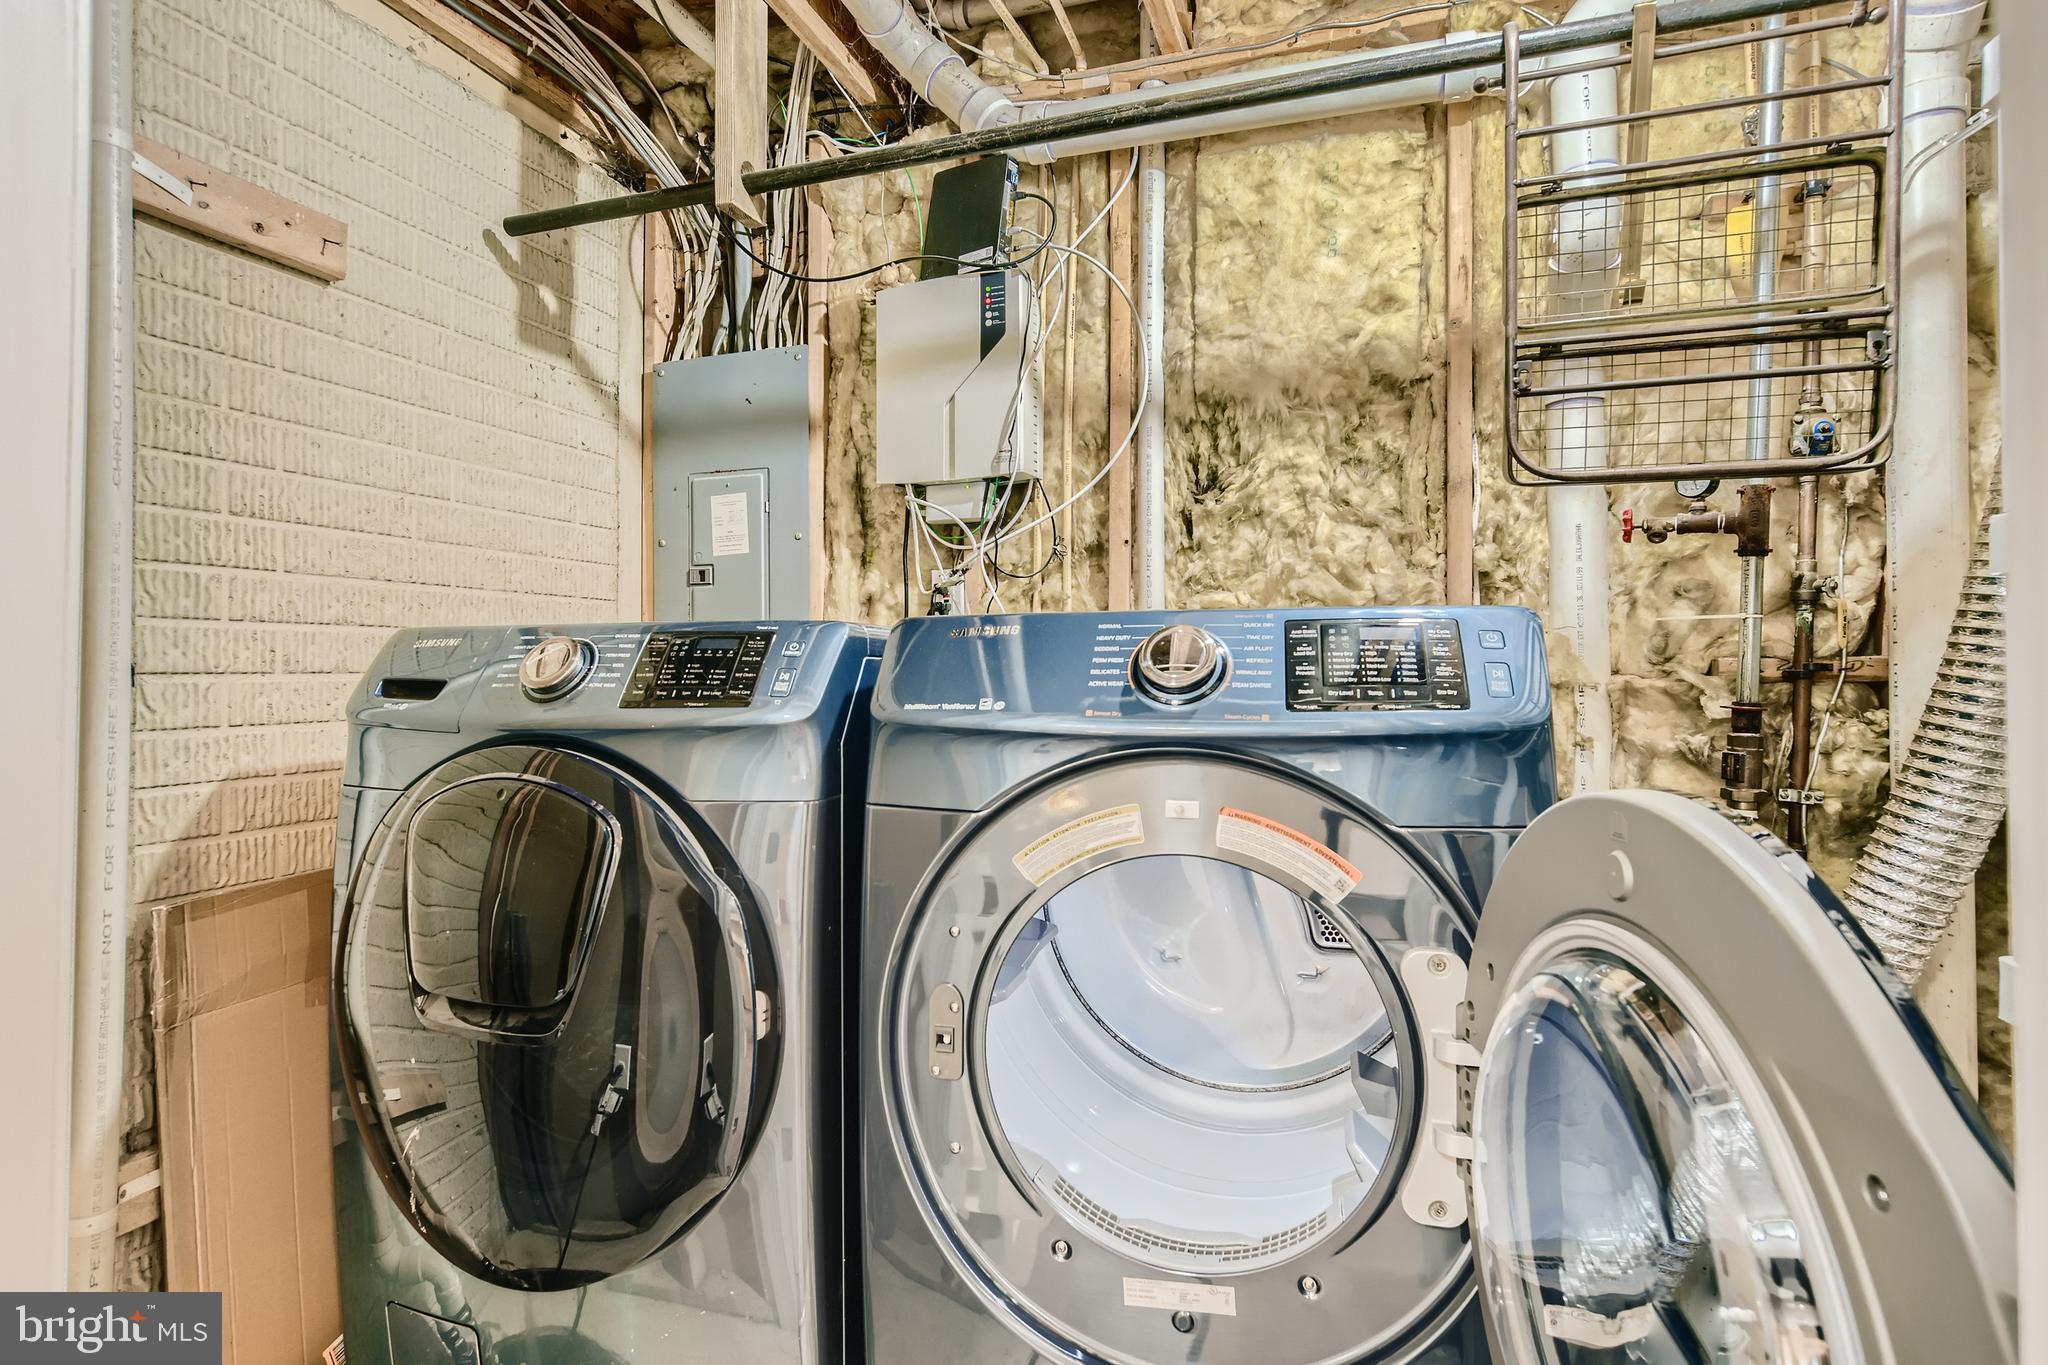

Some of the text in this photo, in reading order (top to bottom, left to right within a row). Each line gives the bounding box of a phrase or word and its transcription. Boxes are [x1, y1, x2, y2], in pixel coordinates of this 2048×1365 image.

[951, 624, 1021, 638] SAMSUNG
[106, 708, 118, 828] PRESSURE
[1234, 813, 1261, 826] WARNING
[1028, 838, 1050, 854] CAUTION
[104, 845, 114, 891] FOR
[102, 909, 112, 955] NOT
